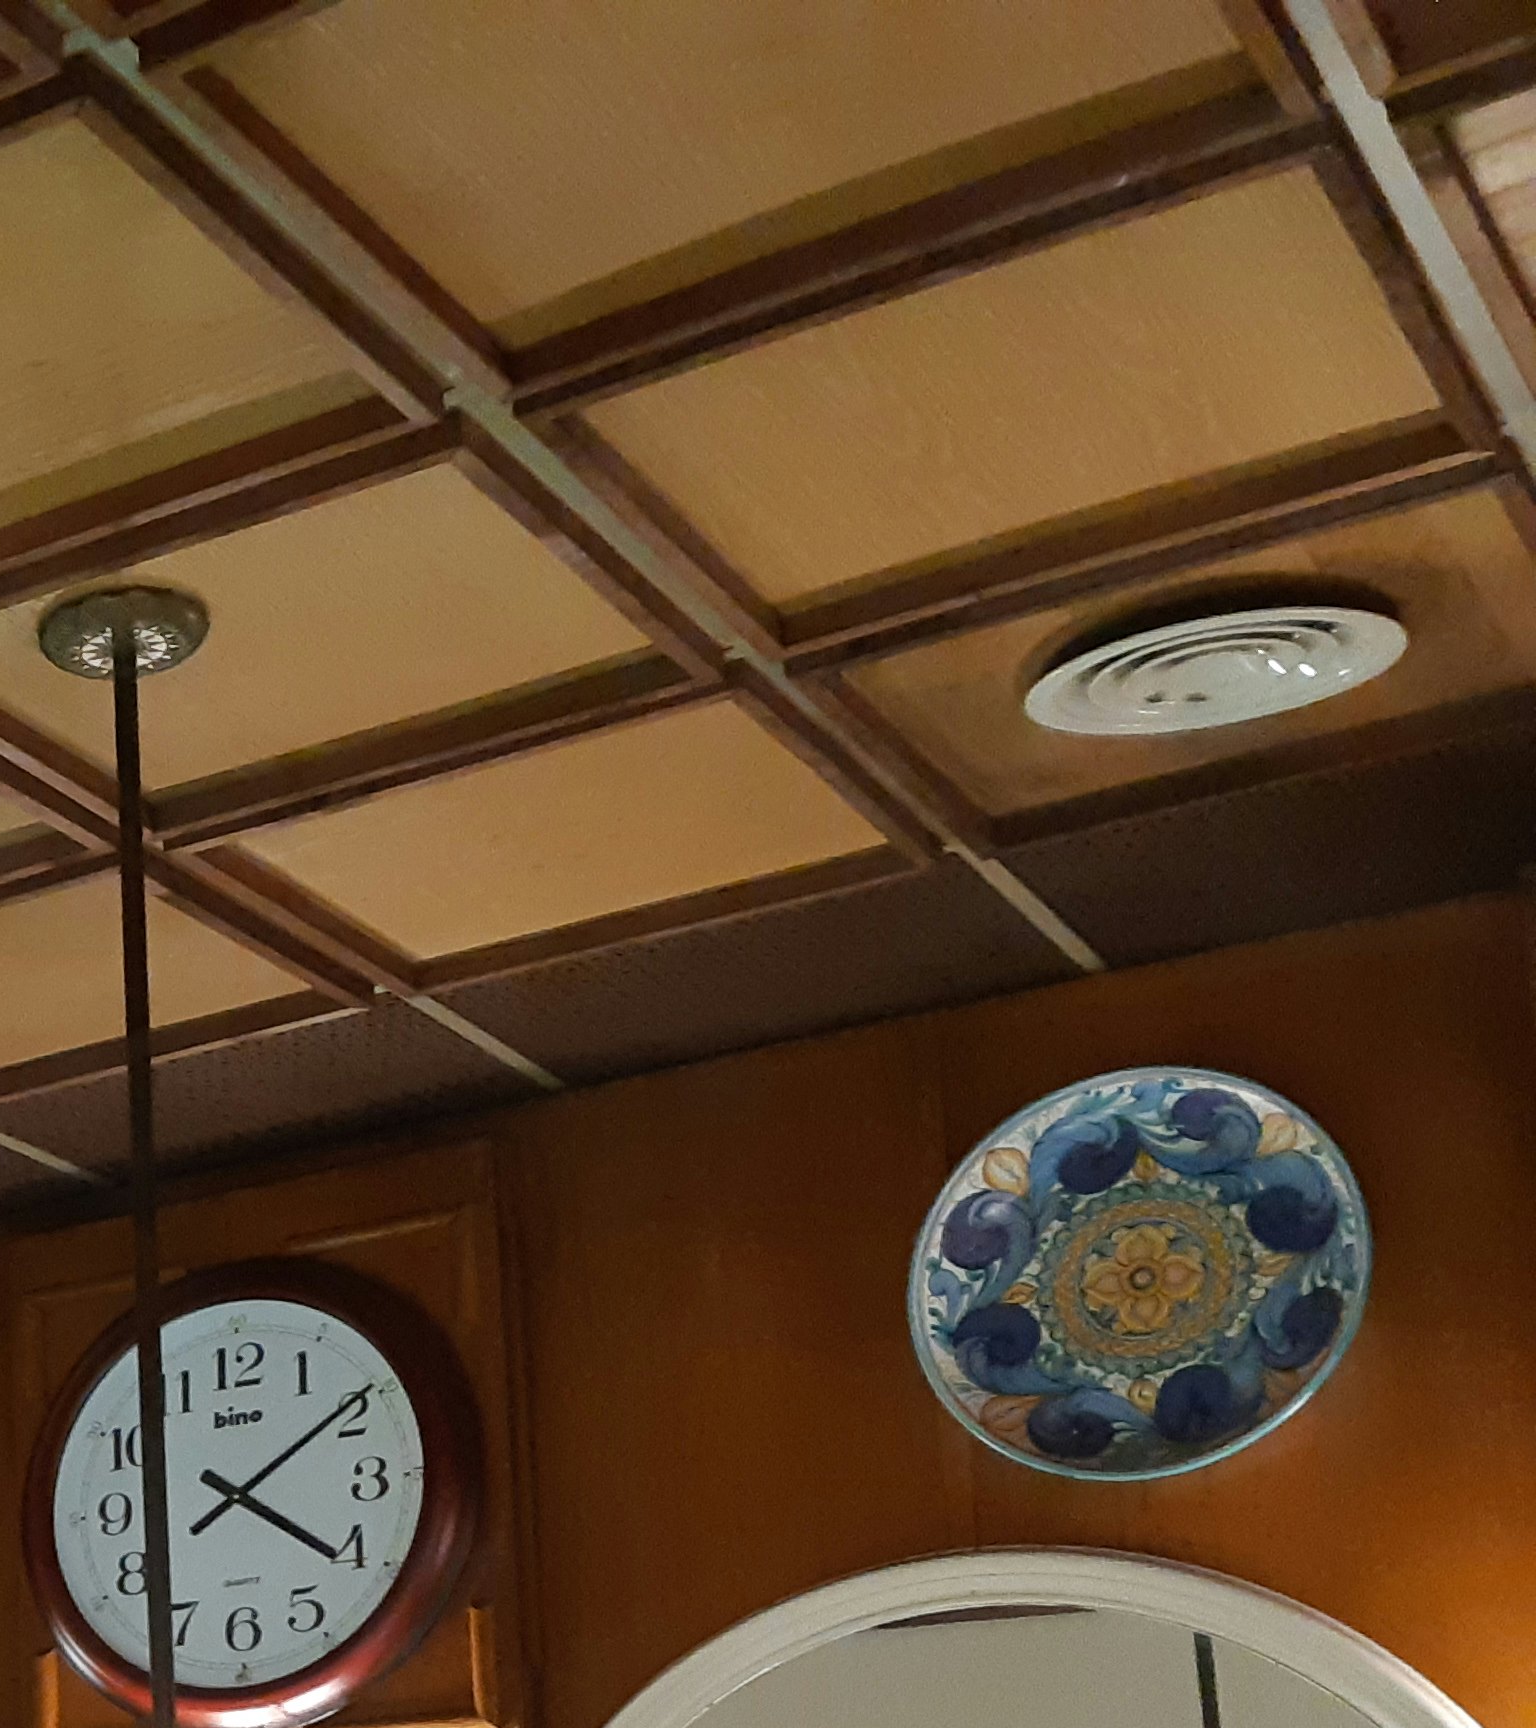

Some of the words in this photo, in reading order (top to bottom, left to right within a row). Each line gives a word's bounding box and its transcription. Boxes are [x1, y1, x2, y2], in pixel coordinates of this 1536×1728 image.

[212, 1341, 264, 1391] 12
[294, 1350, 311, 1396] 1
[213, 1406, 263, 1429] bino
[337, 1391, 369, 1438] 2
[350, 1455, 389, 1501] 3
[98, 1493, 133, 1536] 9
[330, 1523, 368, 1570] 4
[117, 1551, 148, 1596] 8
[225, 1606, 263, 1652] 6
[287, 1583, 327, 1632] 5
